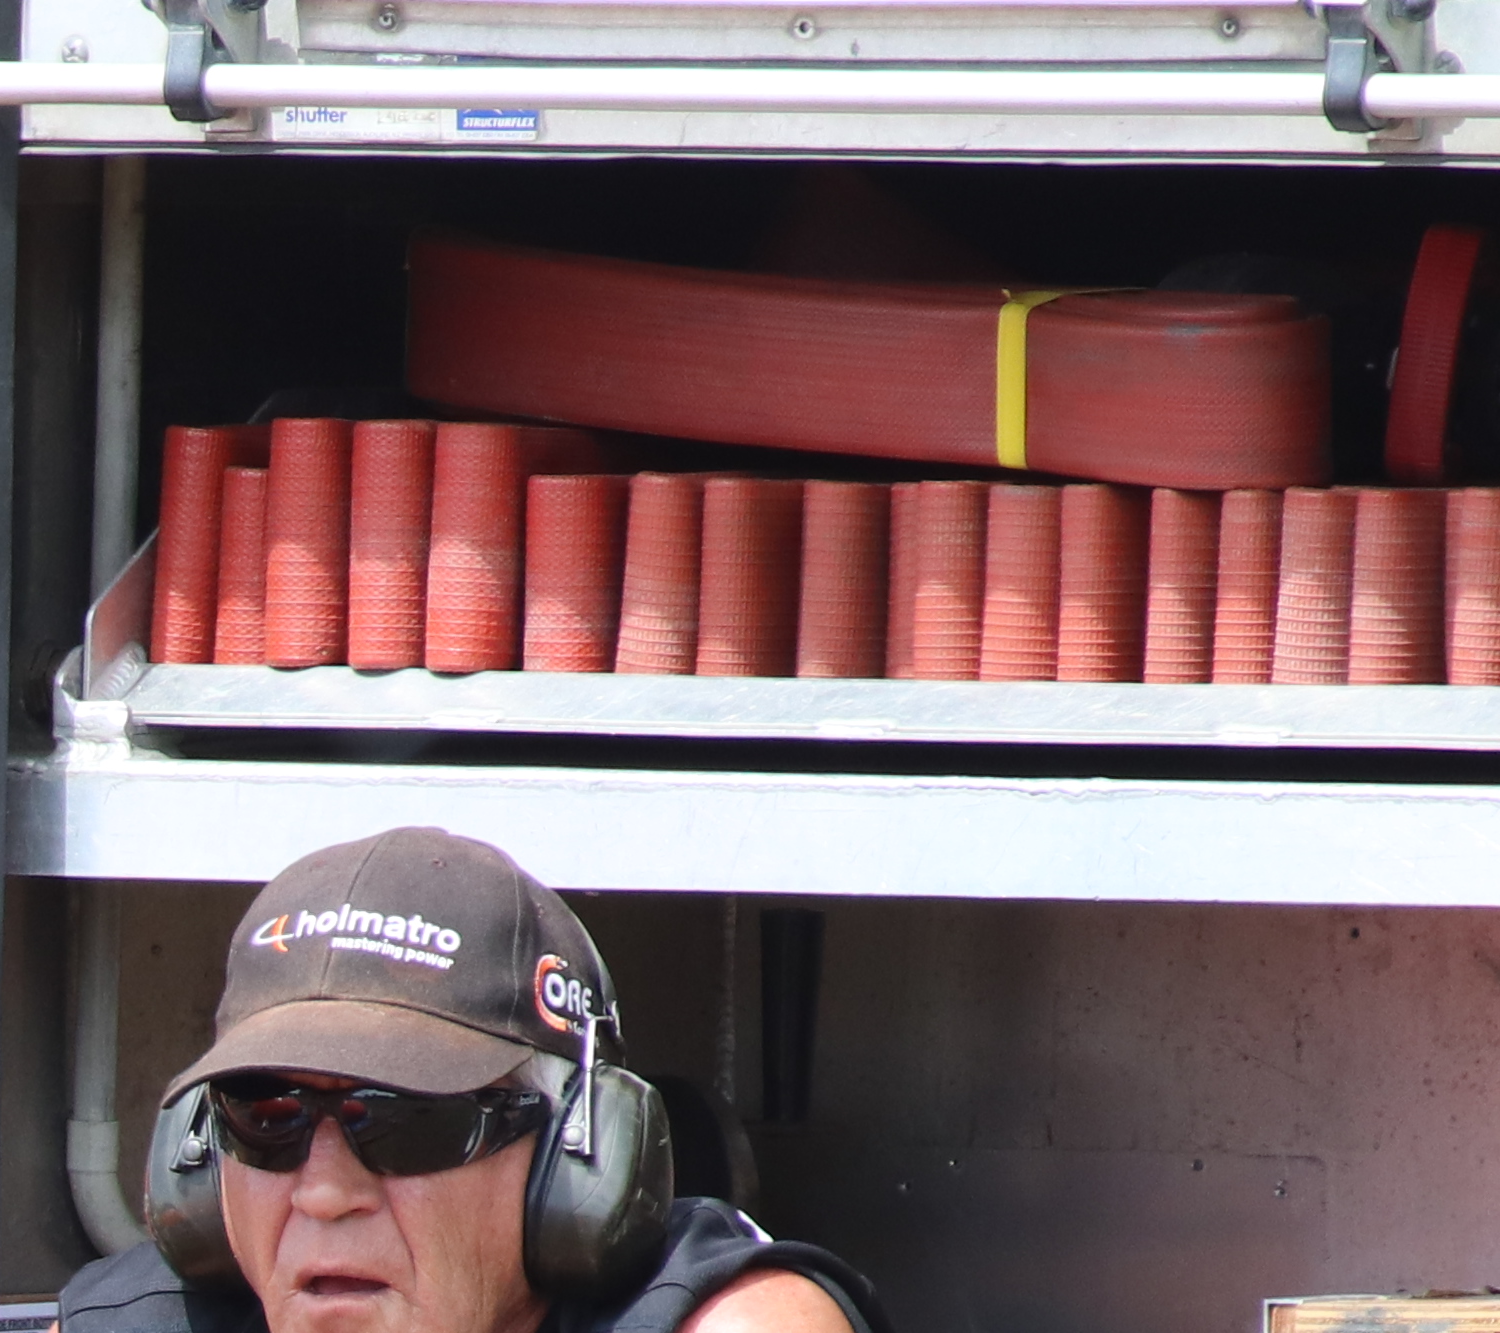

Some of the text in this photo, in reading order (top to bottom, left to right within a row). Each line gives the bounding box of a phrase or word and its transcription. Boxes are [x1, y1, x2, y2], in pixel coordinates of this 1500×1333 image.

[284, 108, 348, 123] shutter
[294, 902, 462, 954] holmatro
[330, 935, 456, 971] mastering power
